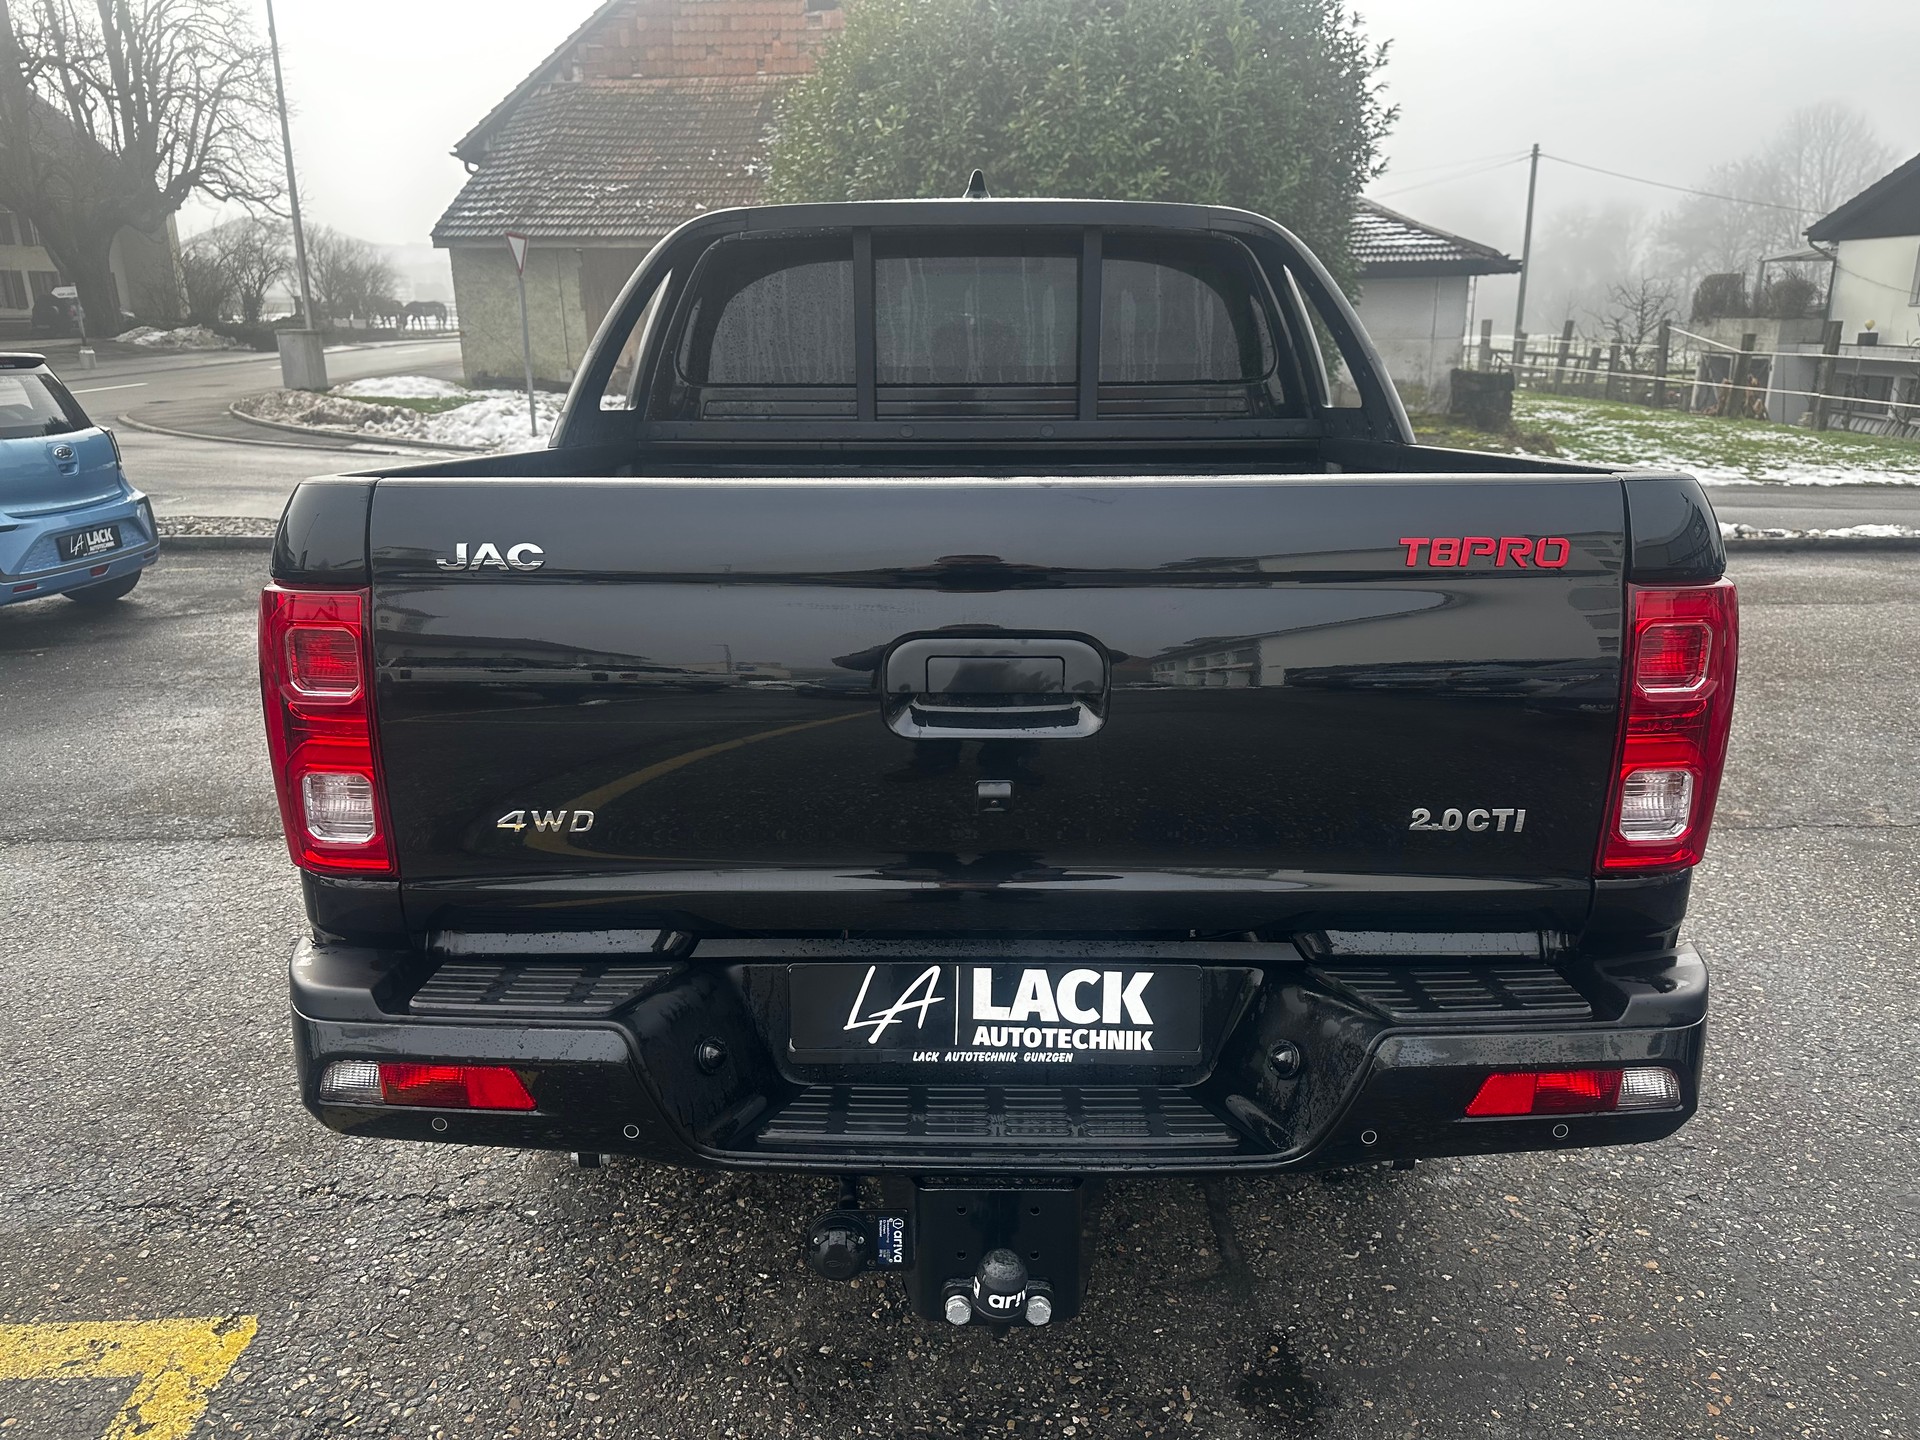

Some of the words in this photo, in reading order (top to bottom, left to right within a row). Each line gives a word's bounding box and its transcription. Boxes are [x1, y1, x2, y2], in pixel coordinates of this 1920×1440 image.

[86, 528, 113, 546] LACK
[436, 542, 545, 571] JAC
[496, 810, 595, 832] 4WD
[1408, 807, 1527, 833] 2.0CTI
[972, 967, 1154, 1025] LACK
[972, 1025, 1154, 1051] AUTOTECHNIK
[912, 1051, 940, 1063] LACK
[944, 1051, 1017, 1063] AUTOTECHNIK
[1023, 1051, 1073, 1063] GUNZGEN
